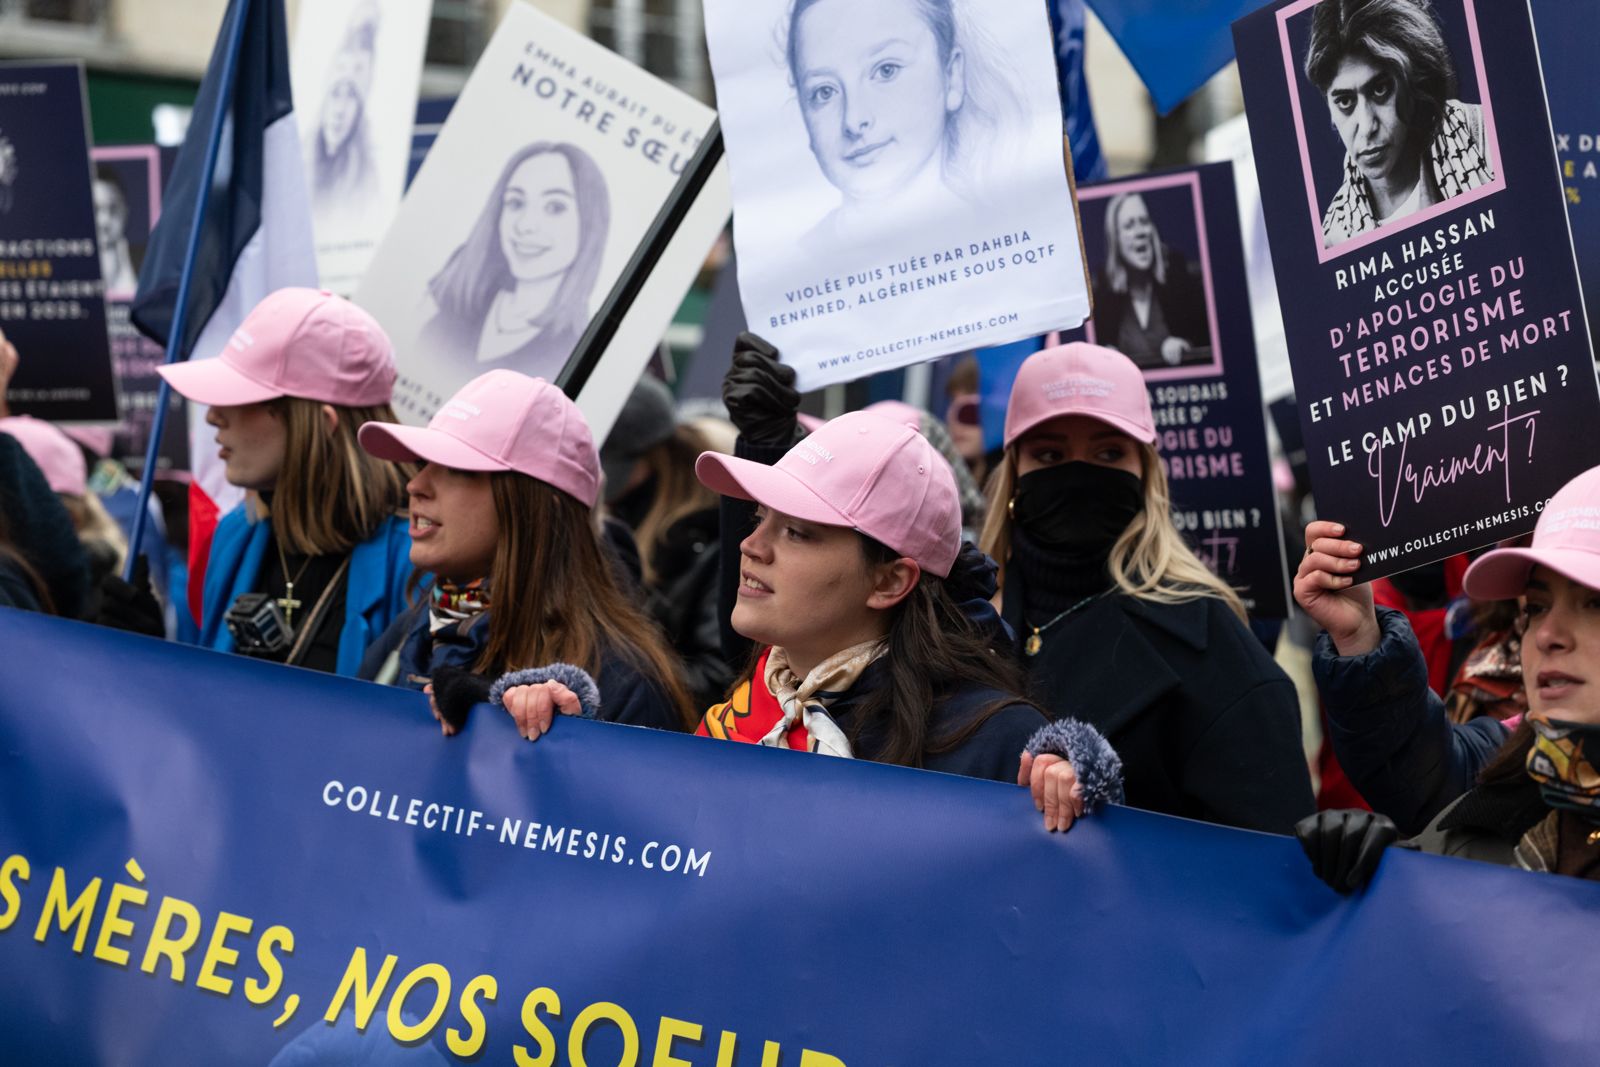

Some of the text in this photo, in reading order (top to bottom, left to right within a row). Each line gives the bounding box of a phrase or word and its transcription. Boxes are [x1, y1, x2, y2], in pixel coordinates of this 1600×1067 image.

[511, 63, 615, 134] NOTRE
[524, 41, 577, 79] EMMA
[582, 77, 648, 118] AURAIT
[651, 115, 676, 135] PU
[770, 244, 1057, 328] BENKIRED, ALGÉRIENNE SOUS OQTF
[785, 230, 1031, 303] VIOLÉE PUIS TUÉE PAR DAHBIA
[1335, 209, 1496, 290] RIMA HASSAN
[1374, 252, 1465, 302] ACCUSÉE
[1490, 256, 1525, 288] DU
[817, 312, 1019, 370] WWW.COLLECTIF-NEMESIS.COM
[1309, 310, 1572, 423] ET MENACES DE MORT
[1339, 289, 1525, 378] TERRORISME
[1155, 382, 1228, 405] SOUDAIS
[1327, 364, 1569, 467] LE CAMP DU BIEN ?
[1204, 425, 1233, 448] DU
[1368, 405, 1540, 527] Vraiment
[1202, 509, 1247, 530] BIEN
[1250, 507, 1261, 528] ?
[322, 780, 712, 877] COLLECTIF-NEMESIS.COM
[34, 857, 300, 1028] MÈRES,
[323, 946, 498, 1057] NOS
